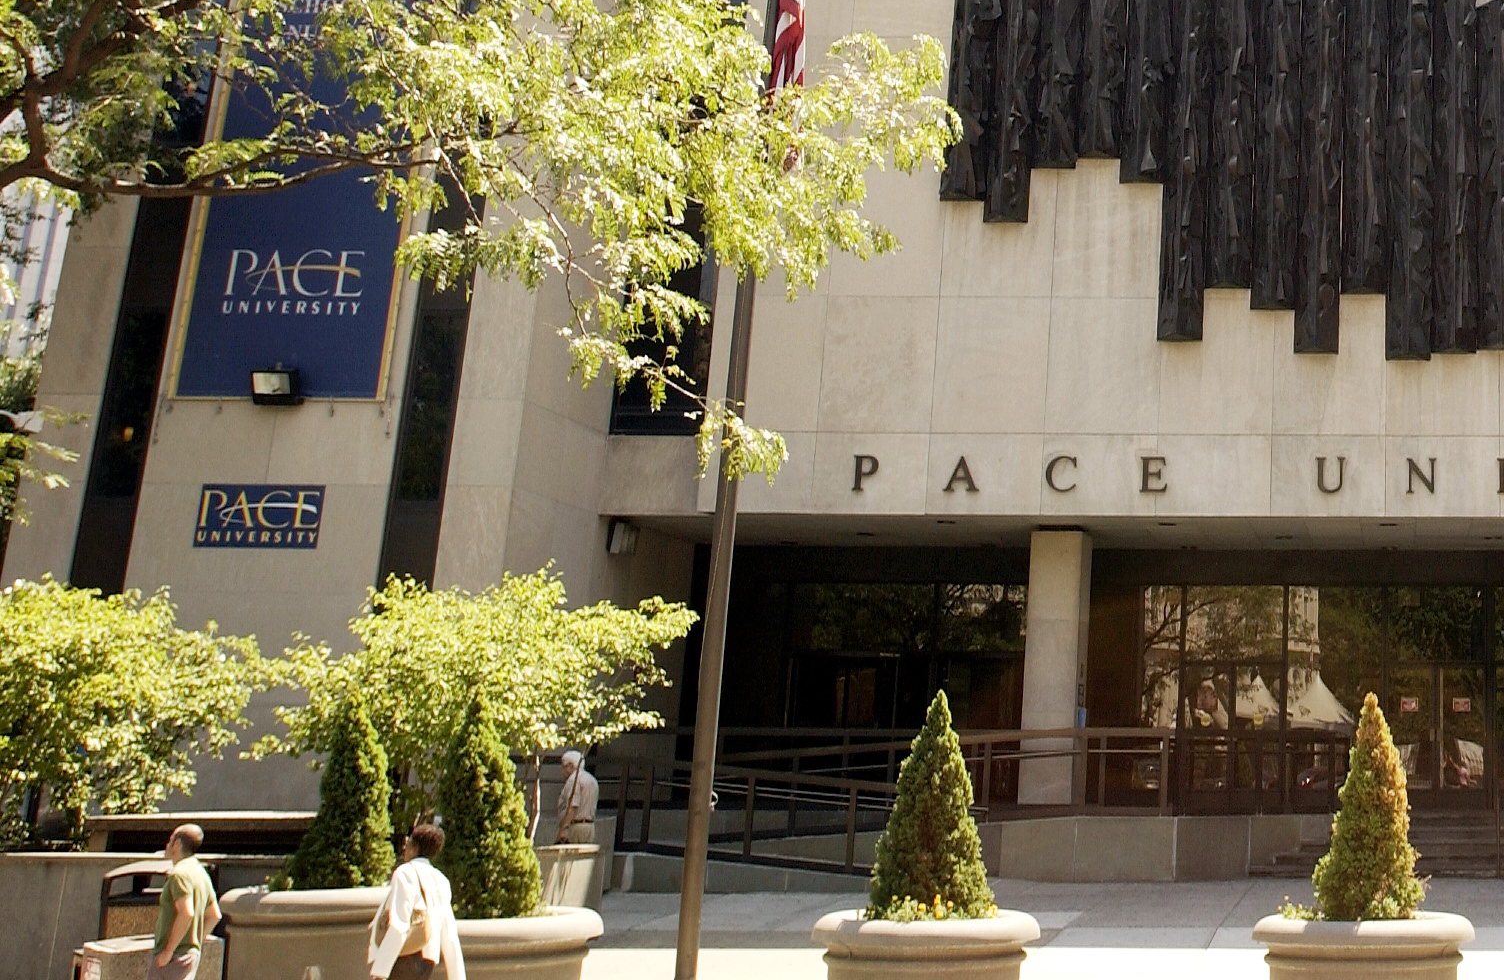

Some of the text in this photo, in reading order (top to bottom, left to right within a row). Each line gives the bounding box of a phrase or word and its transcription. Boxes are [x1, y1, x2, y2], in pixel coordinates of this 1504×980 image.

[224, 248, 366, 298] PACE
[221, 299, 361, 315] UNIVERSITY
[851, 454, 1169, 493] PACE
[199, 490, 321, 529] PACE
[196, 530, 318, 543] UNIVERSITY
